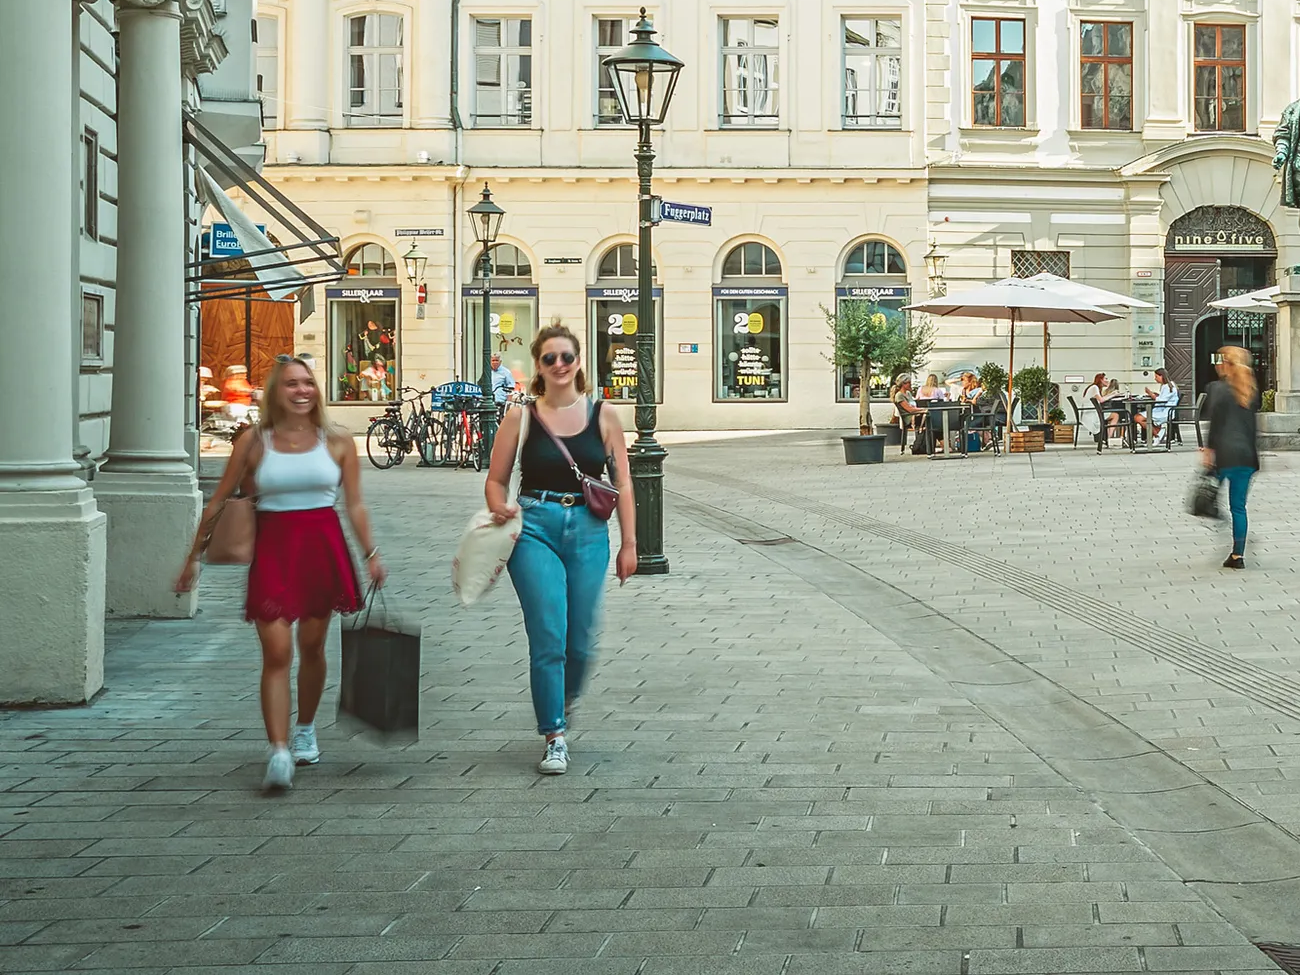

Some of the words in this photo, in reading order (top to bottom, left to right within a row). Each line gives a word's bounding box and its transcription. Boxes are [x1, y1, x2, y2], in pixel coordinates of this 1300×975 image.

[664, 203, 710, 222] Fuggerplatz
[1175, 235, 1212, 244] nine
[1230, 233, 1264, 244] five
[611, 376, 638, 387] TUN!
[736, 375, 765, 386] TUN!
[435, 383, 453, 393] CITY
[464, 383, 483, 393] REHA
